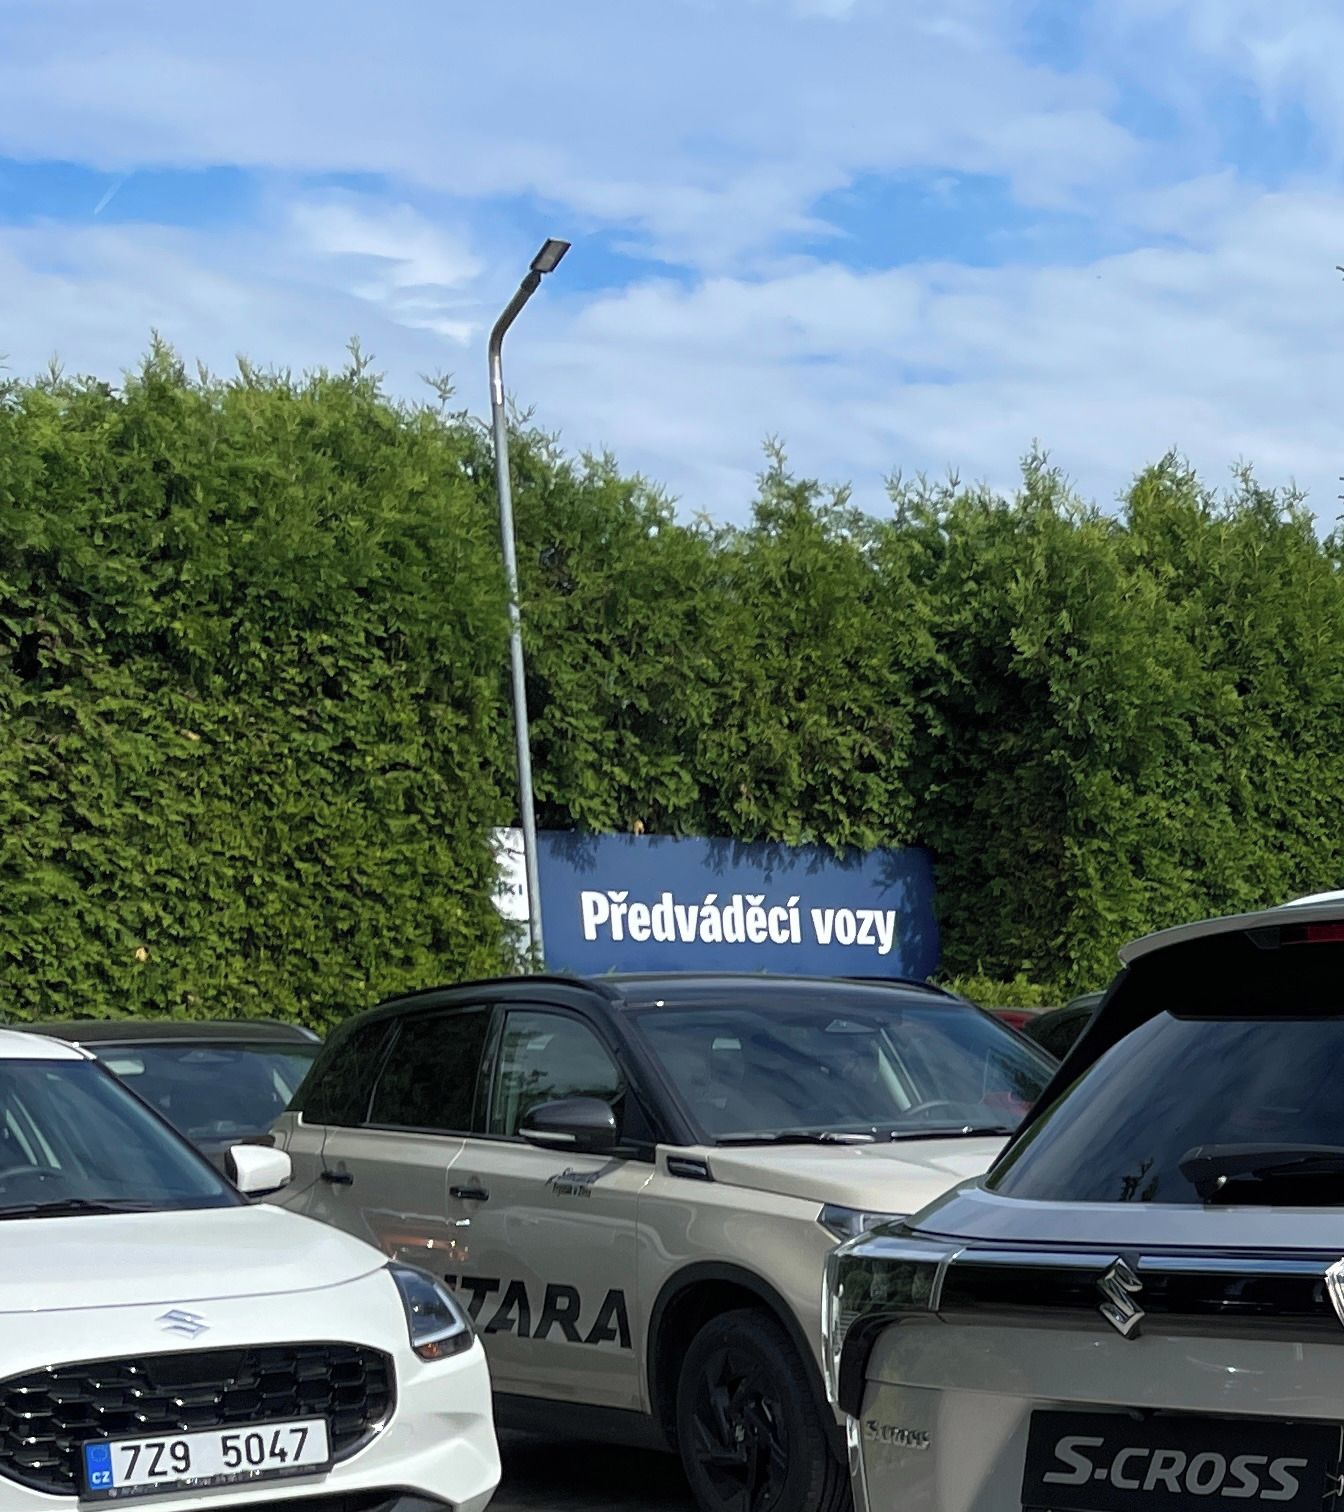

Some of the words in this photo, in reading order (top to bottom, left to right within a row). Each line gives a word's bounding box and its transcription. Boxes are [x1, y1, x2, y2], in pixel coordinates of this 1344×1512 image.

[581, 890, 801, 944] Předváděcí
[811, 907, 896, 955] vozy
[445, 1274, 632, 1349] TARA
[92, 1471, 110, 1485] CZ
[121, 1440, 191, 1481] 7Z9
[221, 1427, 309, 1468] 5047
